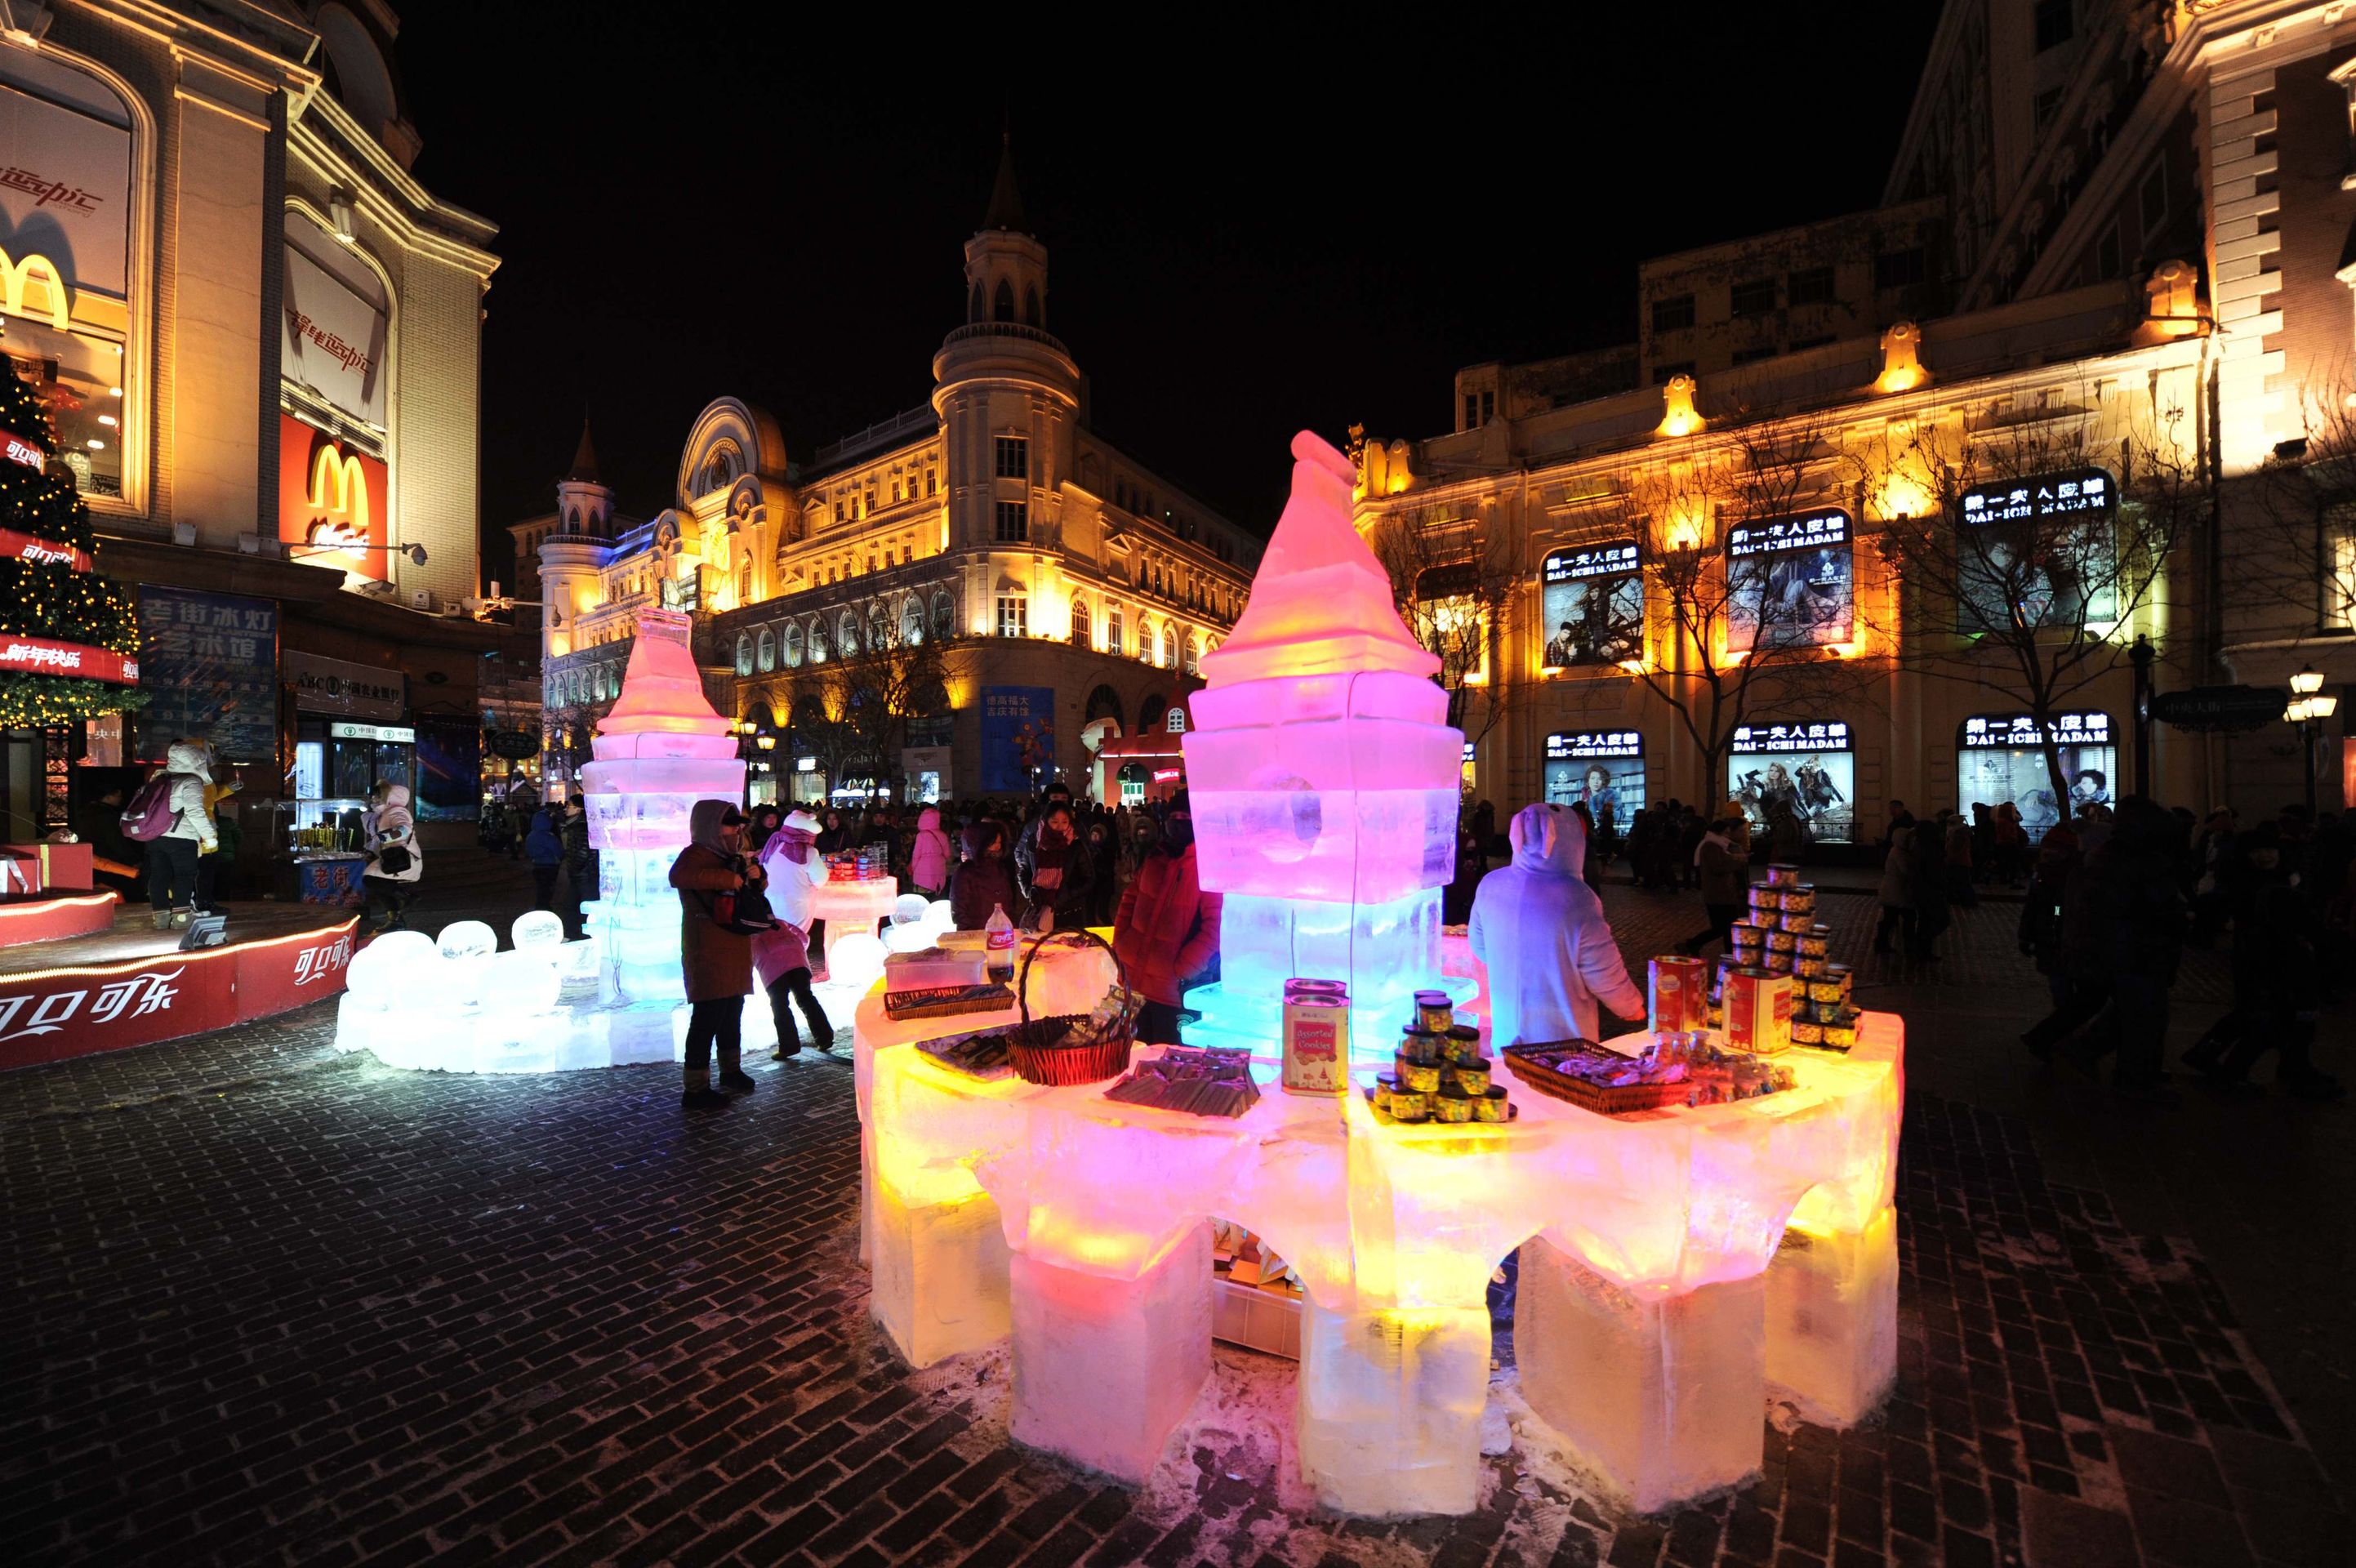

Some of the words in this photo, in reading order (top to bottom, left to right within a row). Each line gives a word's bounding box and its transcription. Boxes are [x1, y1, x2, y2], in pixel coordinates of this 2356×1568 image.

[1966, 505, 2032, 523] DAI-ICH
[1793, 531, 1844, 547] MADAM
[3, 644, 80, 668] 新年快乐
[296, 673, 324, 689] ABC
[341, 679, 399, 702] 中国农业银行
[1733, 740, 1795, 751] DAI-ICHI
[1796, 738, 1846, 749] MADAM
[1966, 733, 2042, 745] DAI-ICHI
[1548, 747, 1596, 757] DAI-ICHI
[1597, 746, 1638, 755] MADAM
[293, 929, 352, 986] 可口可乐
